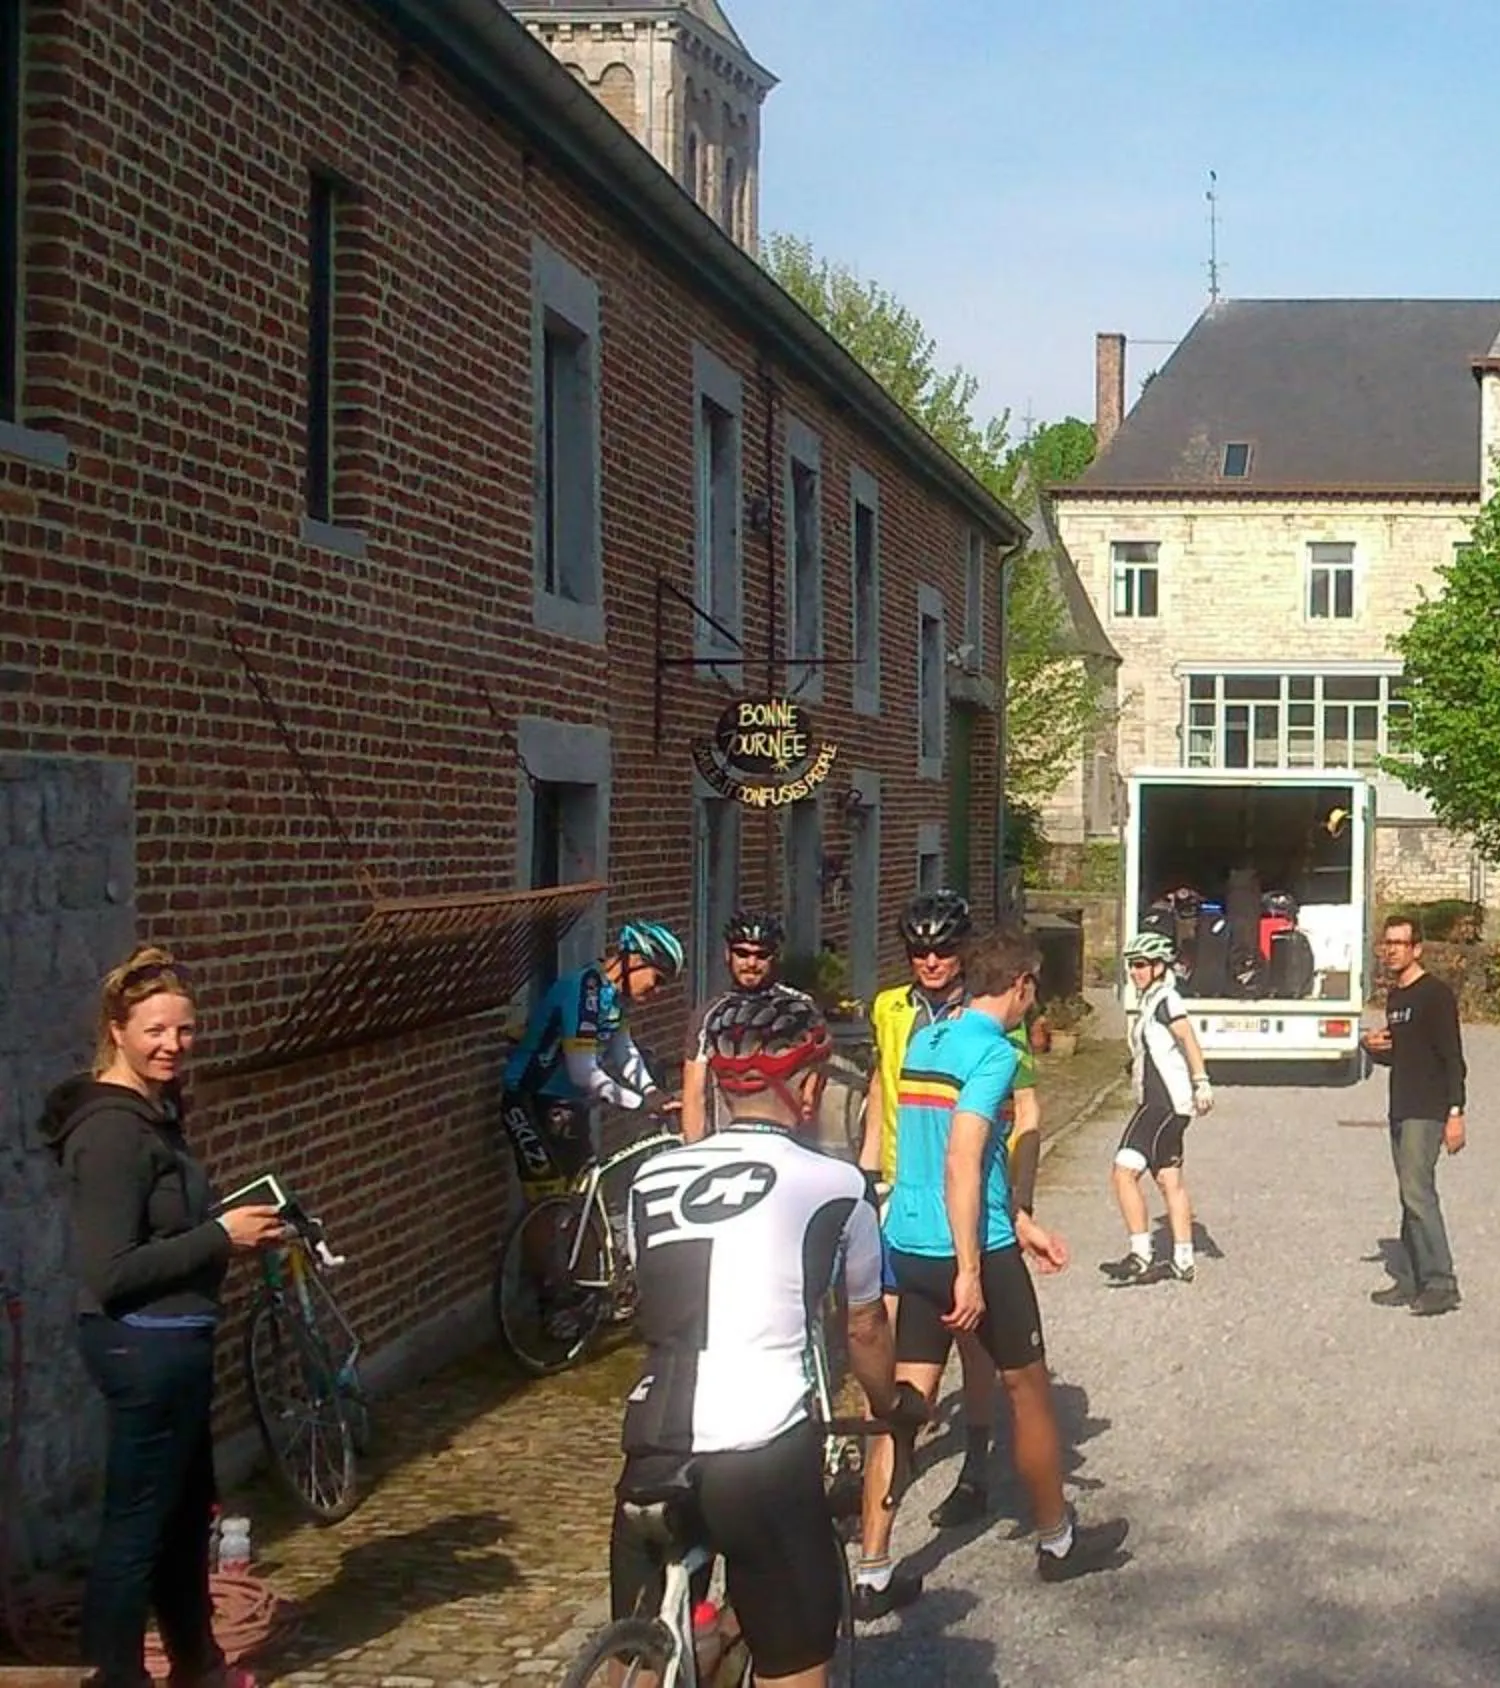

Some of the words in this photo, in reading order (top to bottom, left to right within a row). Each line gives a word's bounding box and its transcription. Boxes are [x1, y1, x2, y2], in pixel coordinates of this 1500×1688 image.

[737, 698, 800, 728] BONNE
[736, 779, 810, 808] CONFUSES
[803, 741, 839, 790] PEOPLE
[505, 1107, 547, 1170] SKLZ
